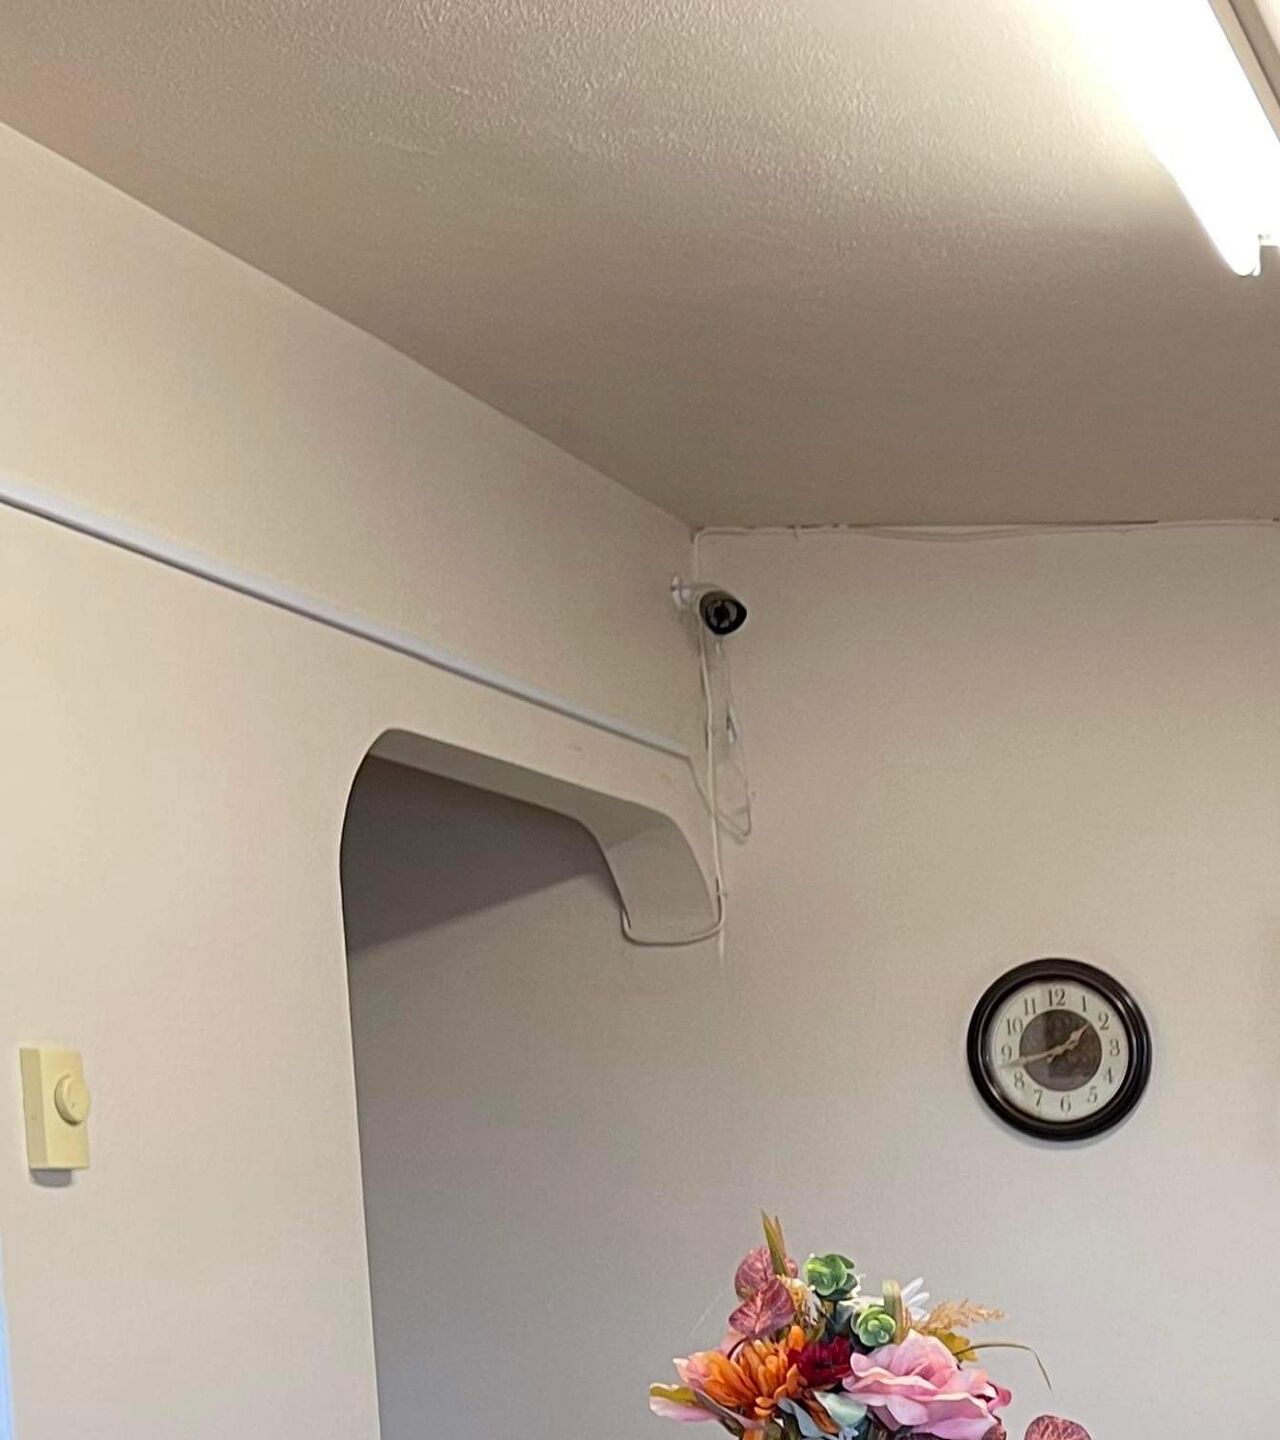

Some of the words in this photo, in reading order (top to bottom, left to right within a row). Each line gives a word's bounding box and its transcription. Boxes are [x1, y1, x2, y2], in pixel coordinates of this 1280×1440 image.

[1023, 997, 1036, 1015] 11
[1047, 988, 1066, 1007] 12
[1081, 995, 1088, 1013] 1
[1006, 1017, 1023, 1036] 10
[1098, 1012, 1110, 1031] 2
[1001, 1045, 1012, 1061] 9
[1109, 1039, 1121, 1057] 3
[1014, 1071, 1025, 1089] 8
[1103, 1067, 1113, 1085] 4
[1033, 1089, 1044, 1107] 7
[1087, 1085, 1098, 1104] 5
[1060, 1095, 1072, 1113] 6
